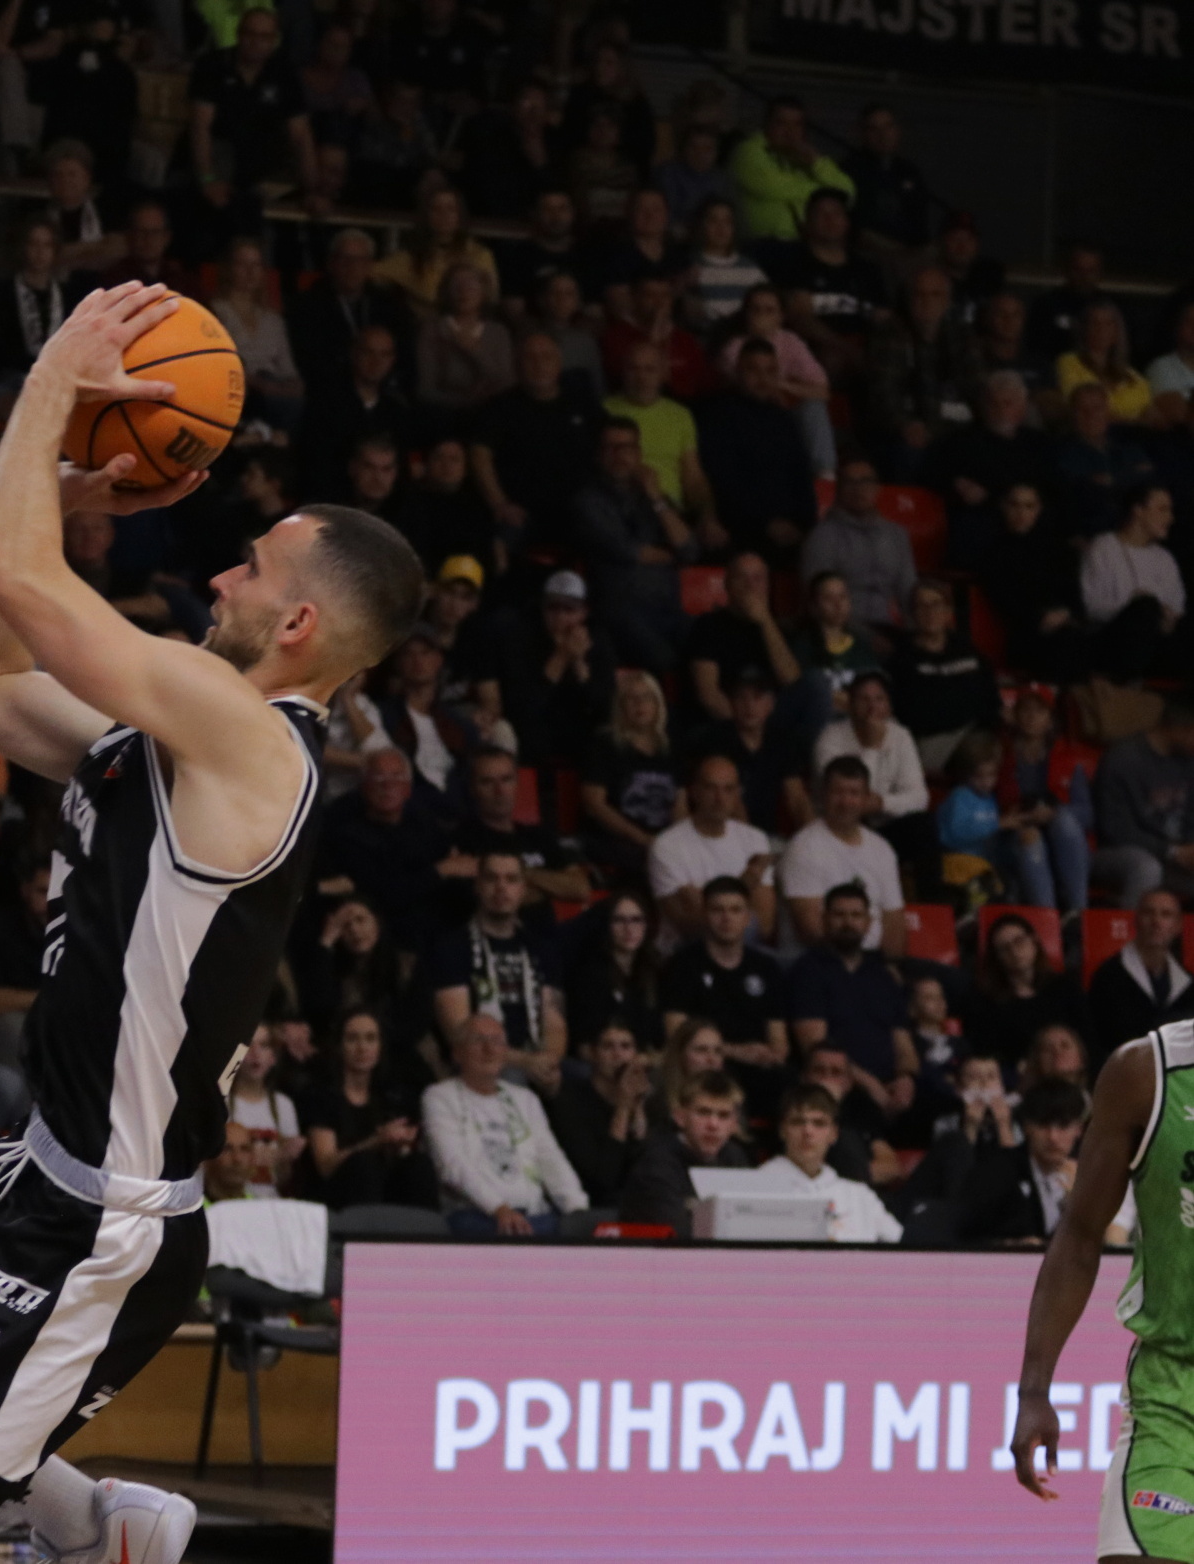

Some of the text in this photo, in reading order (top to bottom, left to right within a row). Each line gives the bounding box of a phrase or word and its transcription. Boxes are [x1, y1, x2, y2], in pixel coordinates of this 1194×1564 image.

[1099, 2, 1183, 59] SR
[433, 1378, 846, 1473] PRIHRAJ
[871, 1381, 971, 1473] MI
